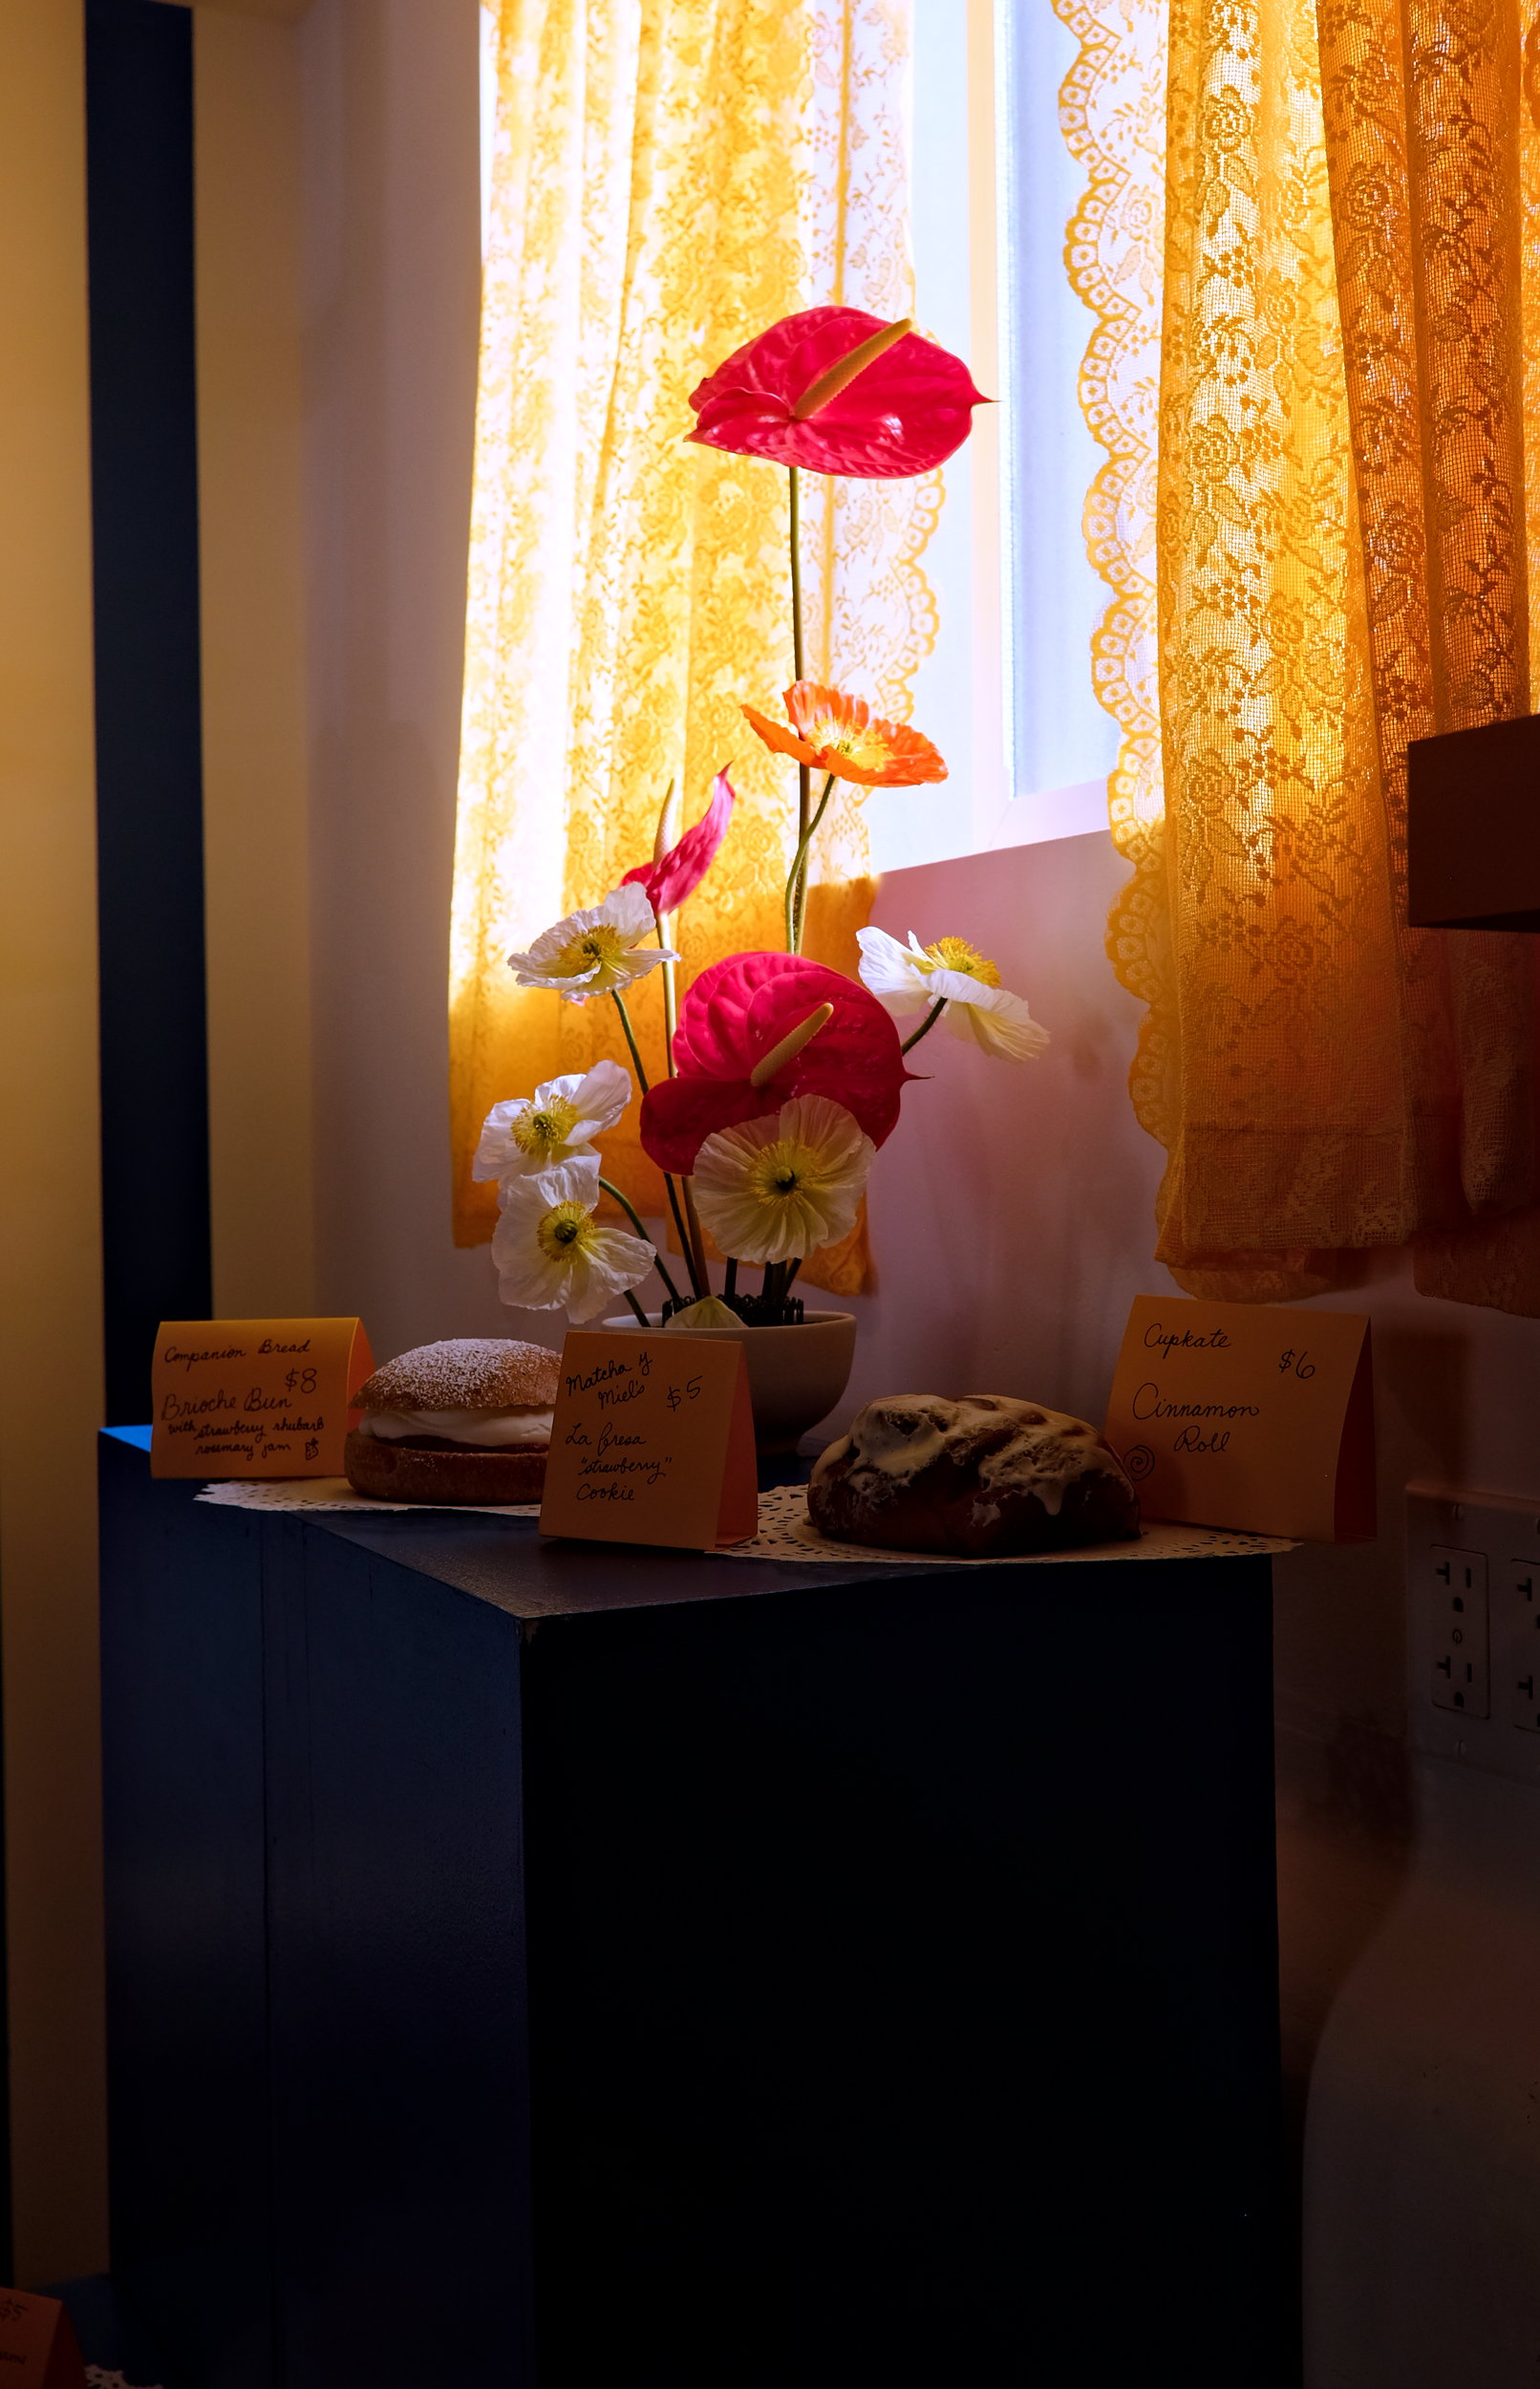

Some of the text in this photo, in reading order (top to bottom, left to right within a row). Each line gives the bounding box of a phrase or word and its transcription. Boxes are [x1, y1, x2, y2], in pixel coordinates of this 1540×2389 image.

[164, 1339, 311, 1372] Companion Bread
[1144, 1323, 1231, 1360] Cupkate
[565, 1351, 654, 1397] Matcha y
[1278, 1349, 1315, 1379] $6
[285, 1367, 318, 1394] $8
[666, 1375, 703, 1412] $5
[160, 1387, 293, 1421] Brioche Bun
[1131, 1382, 1261, 1420] Cinnamon
[168, 1416, 325, 1444] with strawberry rhubarb
[565, 1423, 593, 1445] La
[1173, 1425, 1231, 1453] Roll
[194, 1443, 291, 1461] rosemary jam
[575, 1482, 635, 1501] Cookie
